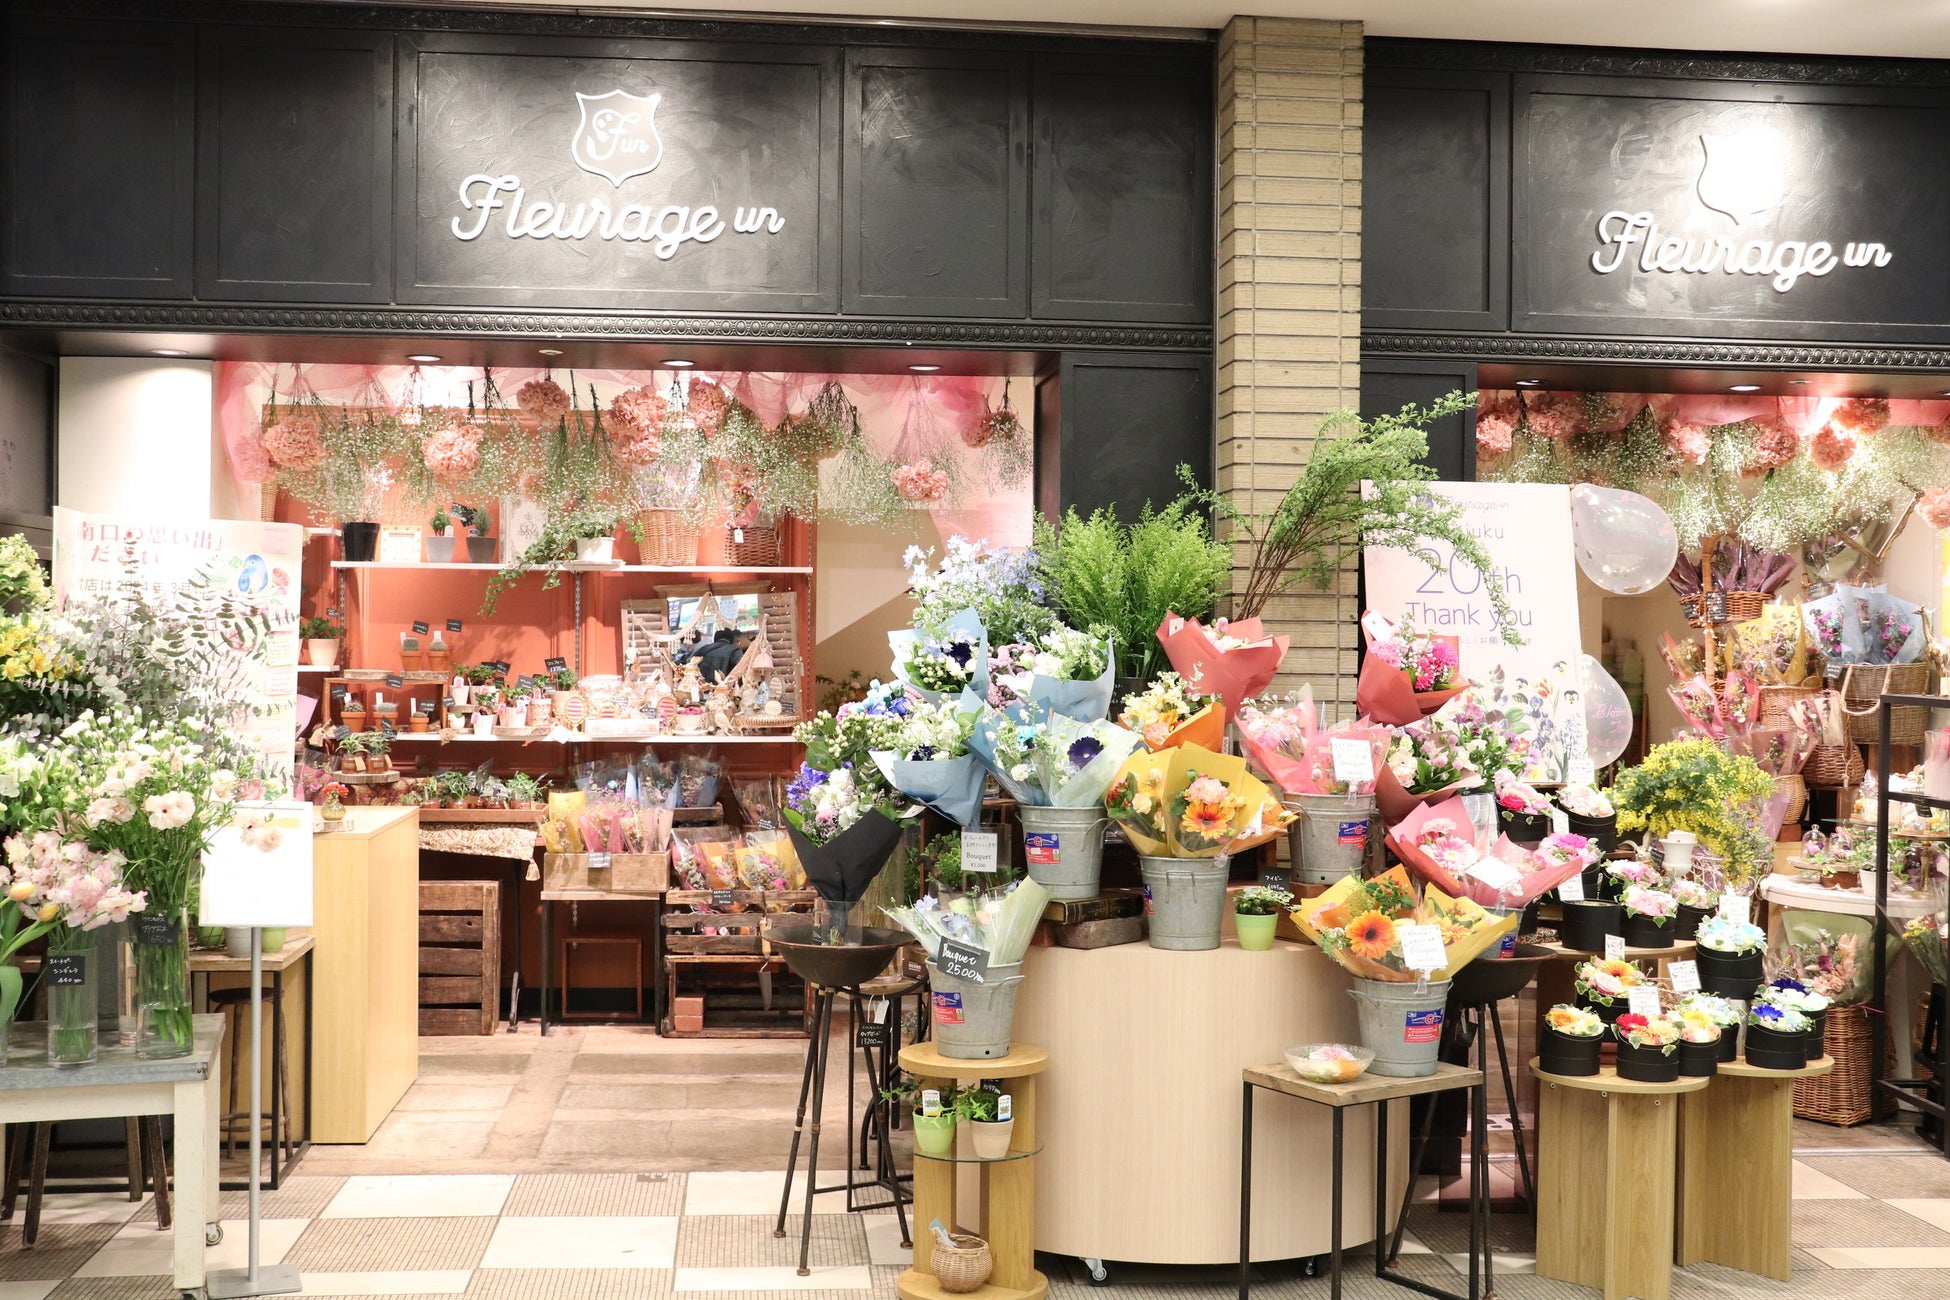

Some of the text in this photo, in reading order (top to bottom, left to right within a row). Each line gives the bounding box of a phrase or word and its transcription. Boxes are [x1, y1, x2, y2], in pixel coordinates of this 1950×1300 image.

[451, 173, 786, 260] Fleurage un
[1590, 210, 1892, 292] Fleurage un
[1415, 548, 1522, 594] 20th
[1404, 602, 1532, 631] Thank you
[966, 852, 992, 861] Bouquet
[942, 943, 977, 965] Bouquet
